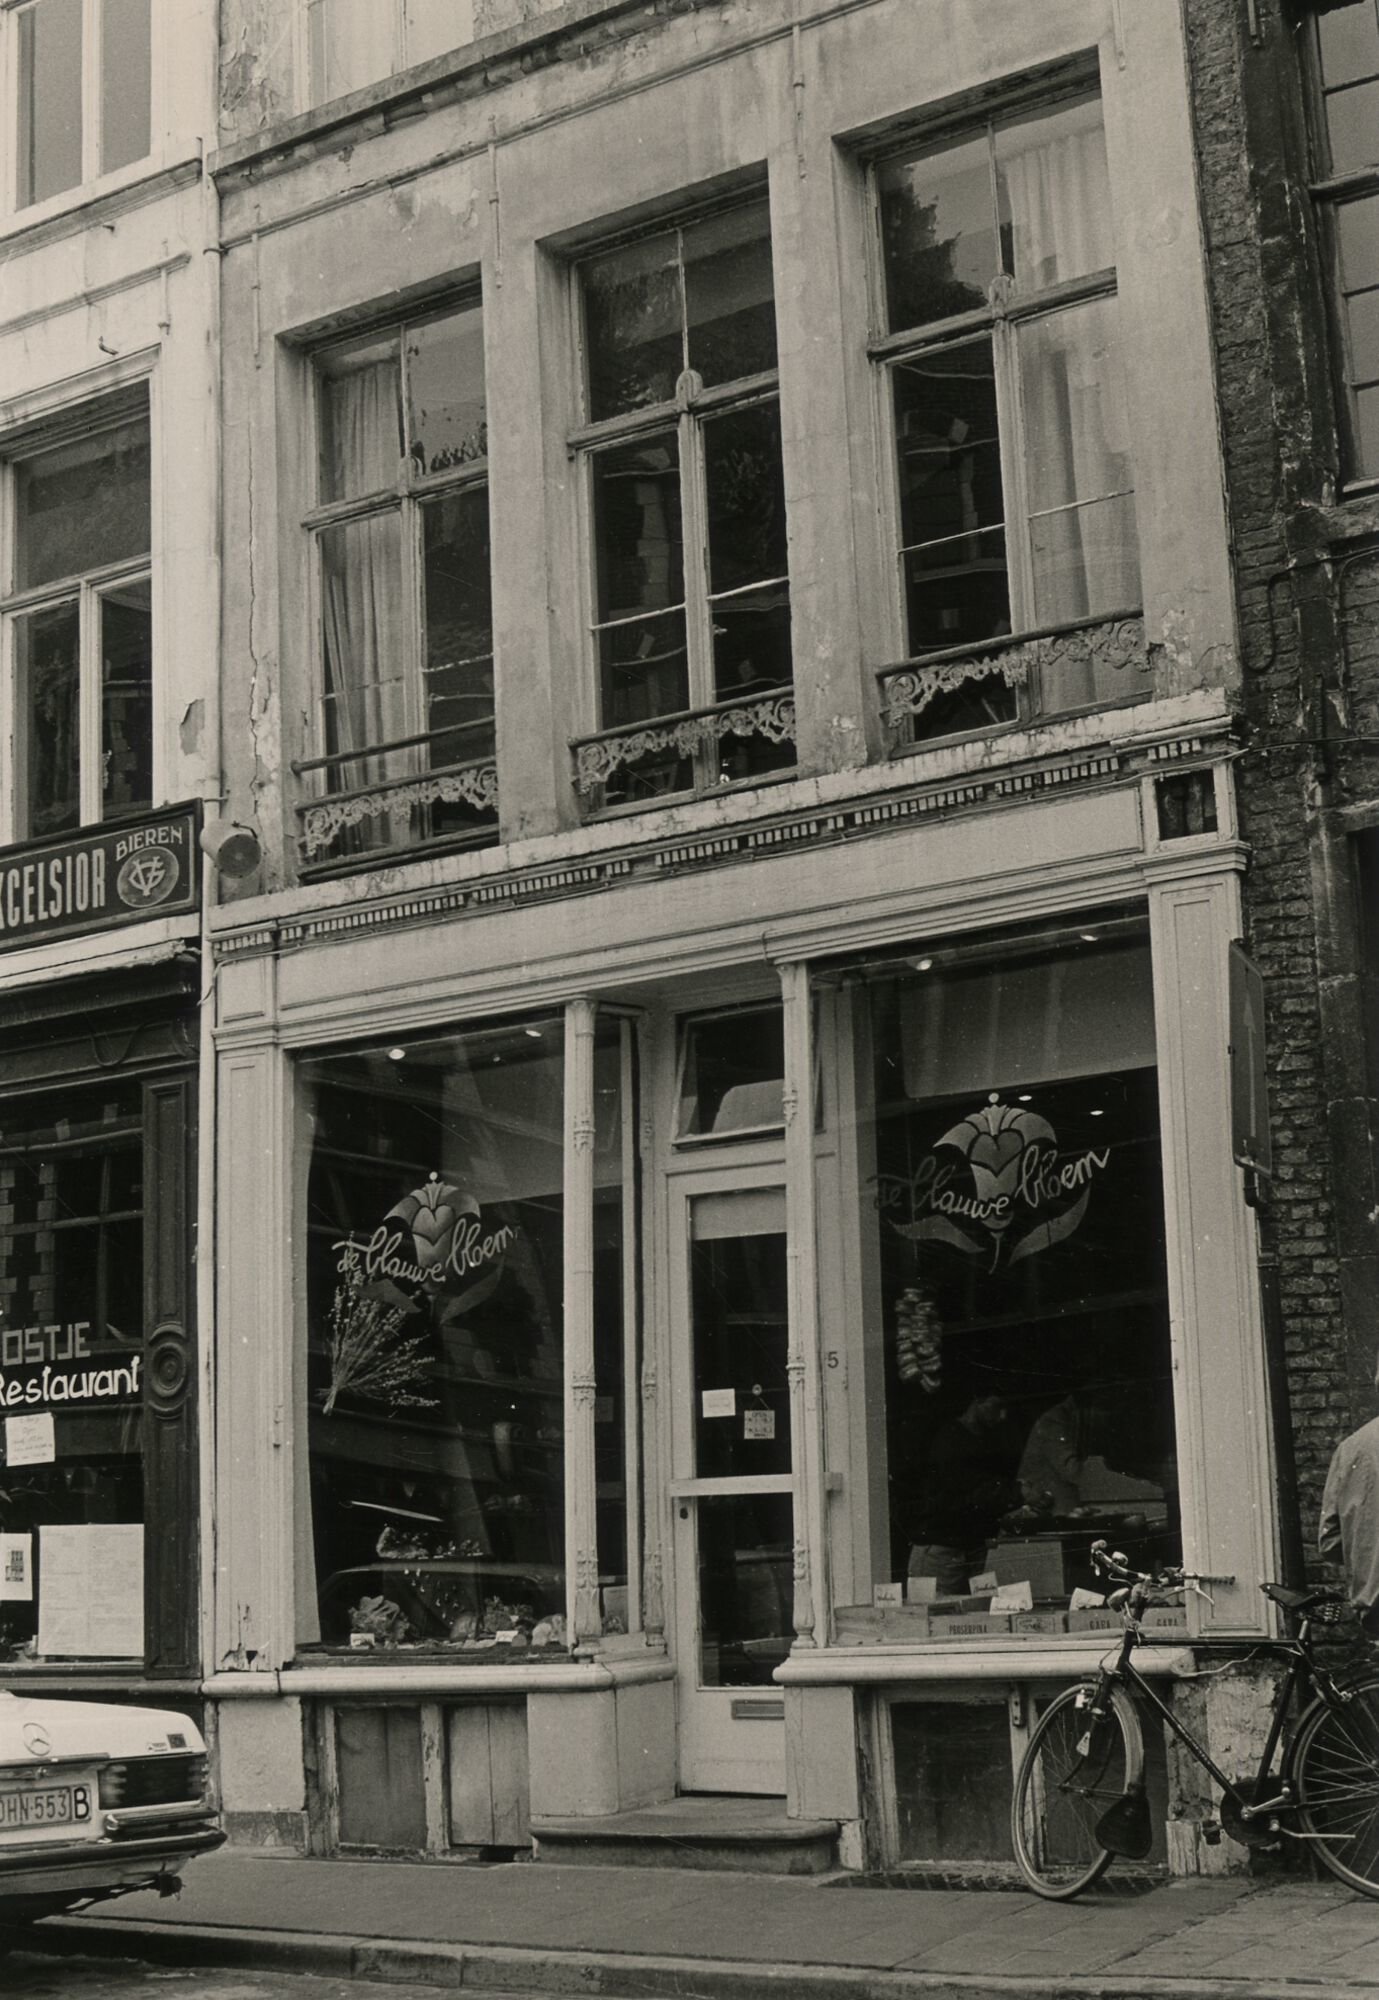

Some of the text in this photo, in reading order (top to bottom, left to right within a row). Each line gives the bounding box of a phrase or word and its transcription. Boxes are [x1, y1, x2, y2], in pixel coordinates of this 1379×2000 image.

[116, 825, 183, 861] BIEREN
[1014, 1145, 1111, 1208] bloem
[332, 1225, 447, 1282] blauwe
[445, 1217, 517, 1276] bloem
[827, 1352, 839, 1369] 5
[73, 1786, 90, 1819] B
